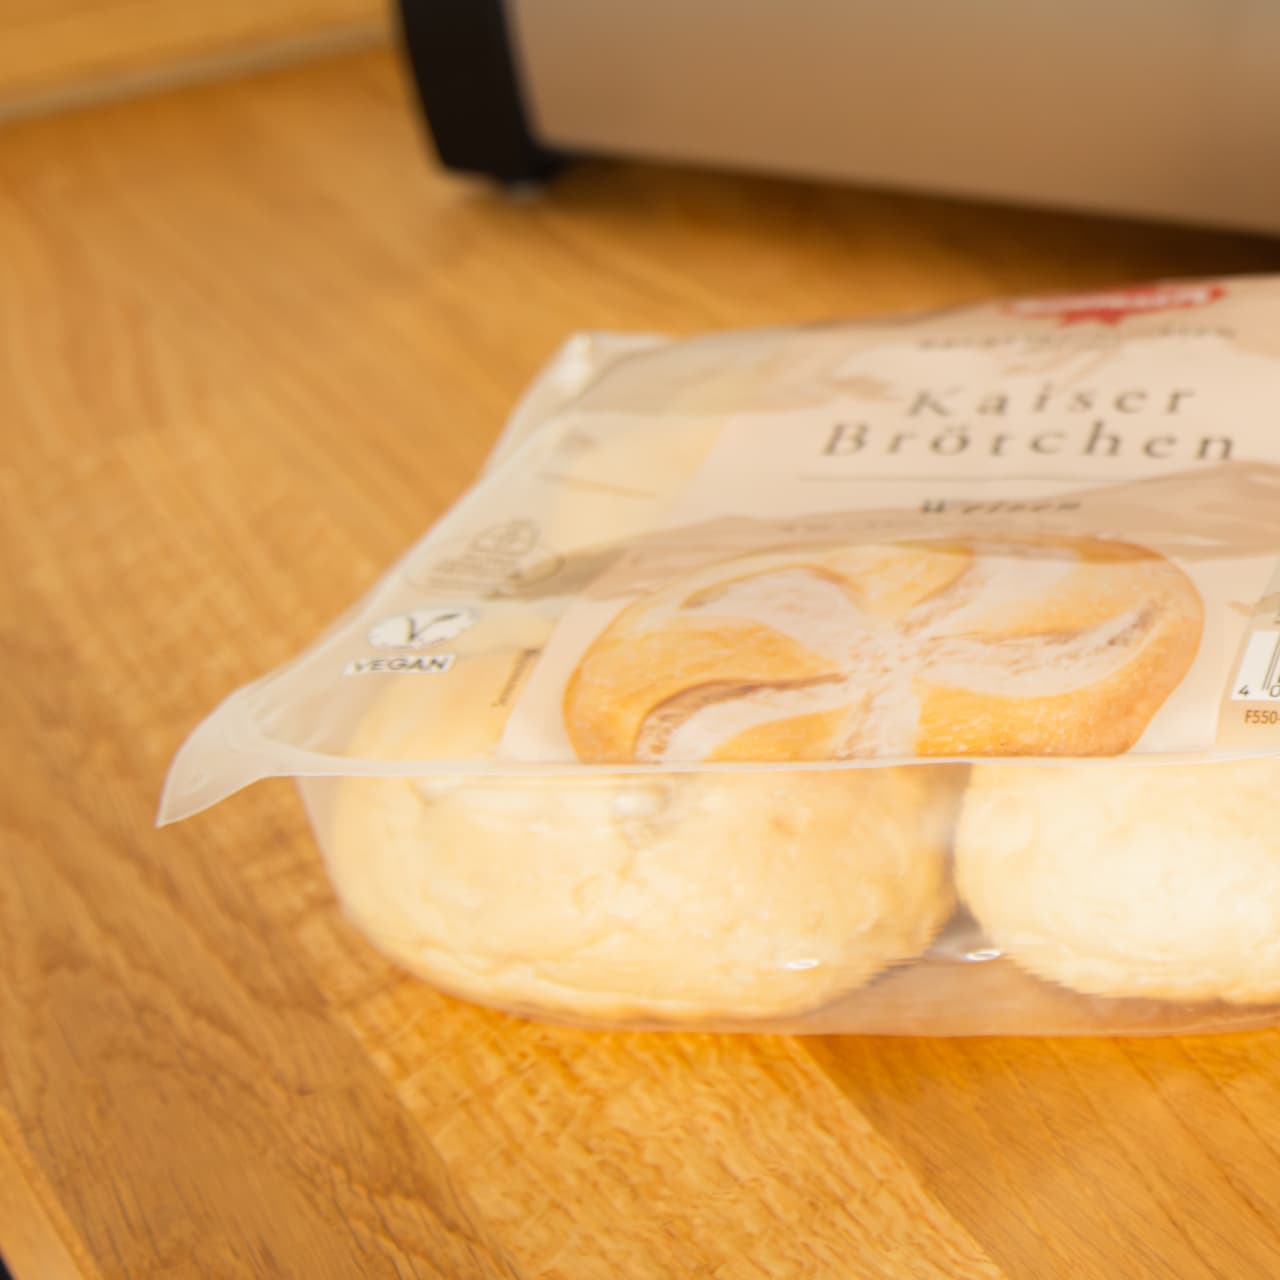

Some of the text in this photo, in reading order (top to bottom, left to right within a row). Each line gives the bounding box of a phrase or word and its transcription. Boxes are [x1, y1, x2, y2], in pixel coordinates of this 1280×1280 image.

[906, 379, 1195, 418] Kaiser
[821, 418, 1236, 461] Brötchen
[354, 656, 448, 672] VEGAN
[1239, 686, 1250, 697] 4
